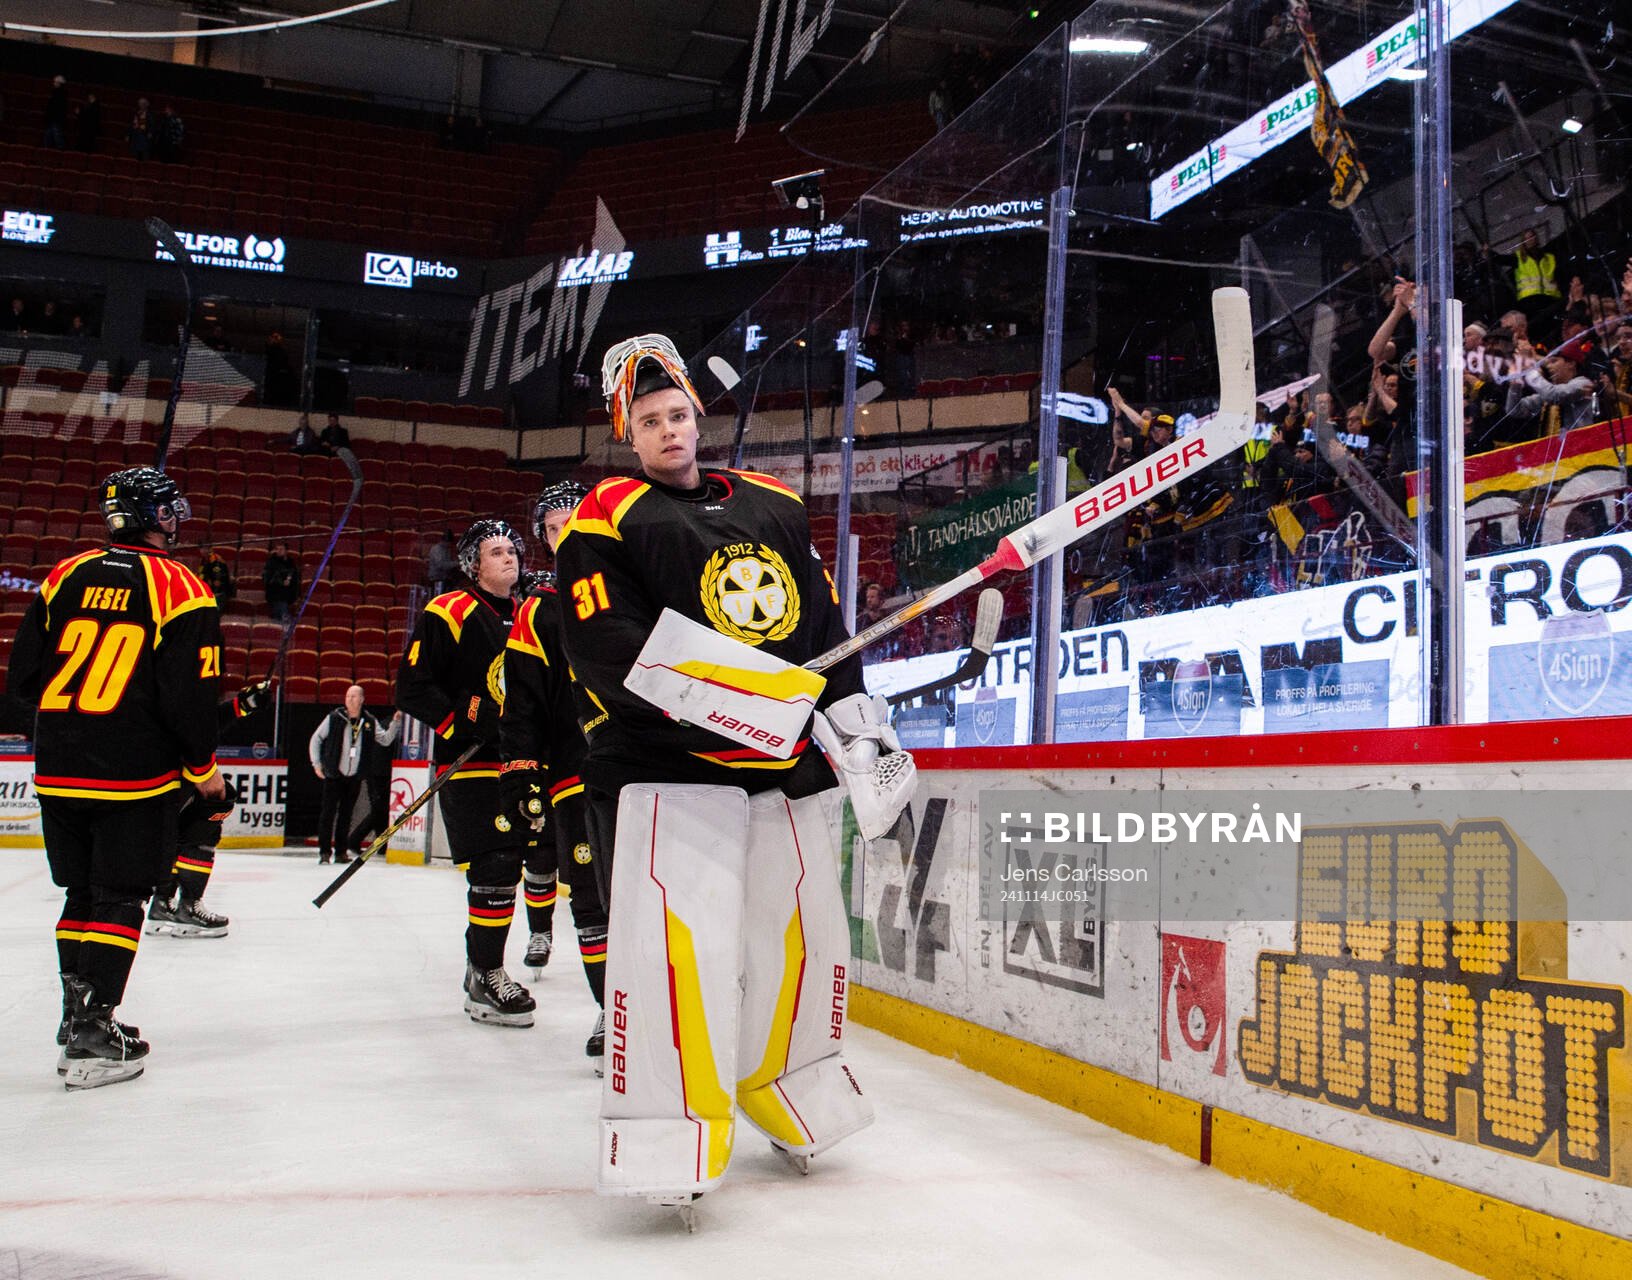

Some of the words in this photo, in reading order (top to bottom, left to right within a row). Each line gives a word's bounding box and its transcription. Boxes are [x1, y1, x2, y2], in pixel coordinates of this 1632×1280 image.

[1266, 88, 1319, 131] PEAB
[1178, 148, 1220, 187] PEAB
[949, 200, 1044, 220] AUTOMOTIVE
[156, 231, 239, 255] LFOR
[212, 257, 284, 272] RESTORATION
[369, 256, 408, 277] ICA
[413, 260, 459, 279] Järbo
[559, 249, 635, 280] KÅAB
[1074, 438, 1208, 528] BAUER
[723, 543, 755, 559] 1912
[741, 567, 753, 581] B
[80, 587, 131, 611] VESEL
[572, 571, 612, 621] 31
[766, 594, 776, 609] F
[1344, 544, 1632, 645] CIRO
[820, 613, 907, 665] HYPRLITE
[38, 617, 147, 715] 20
[1549, 648, 1603, 691] 4Sign
[1177, 689, 1206, 715] 4Sign
[1276, 688, 1305, 700] PROFFS
[1320, 682, 1375, 697] PROFILERING
[1277, 703, 1307, 716] LOKALT
[1336, 699, 1373, 712] SVERIGE
[706, 710, 786, 748] BAUER
[240, 808, 286, 828] bygg
[982, 822, 994, 859] AV
[980, 868, 992, 921] DEL
[1009, 848, 1095, 973] XL
[1301, 831, 1511, 976] EURO
[980, 930, 992, 969] EN
[830, 964, 846, 1040] BAUER
[613, 989, 628, 1095] BAUER
[1242, 959, 1617, 1160] JACKPOT
